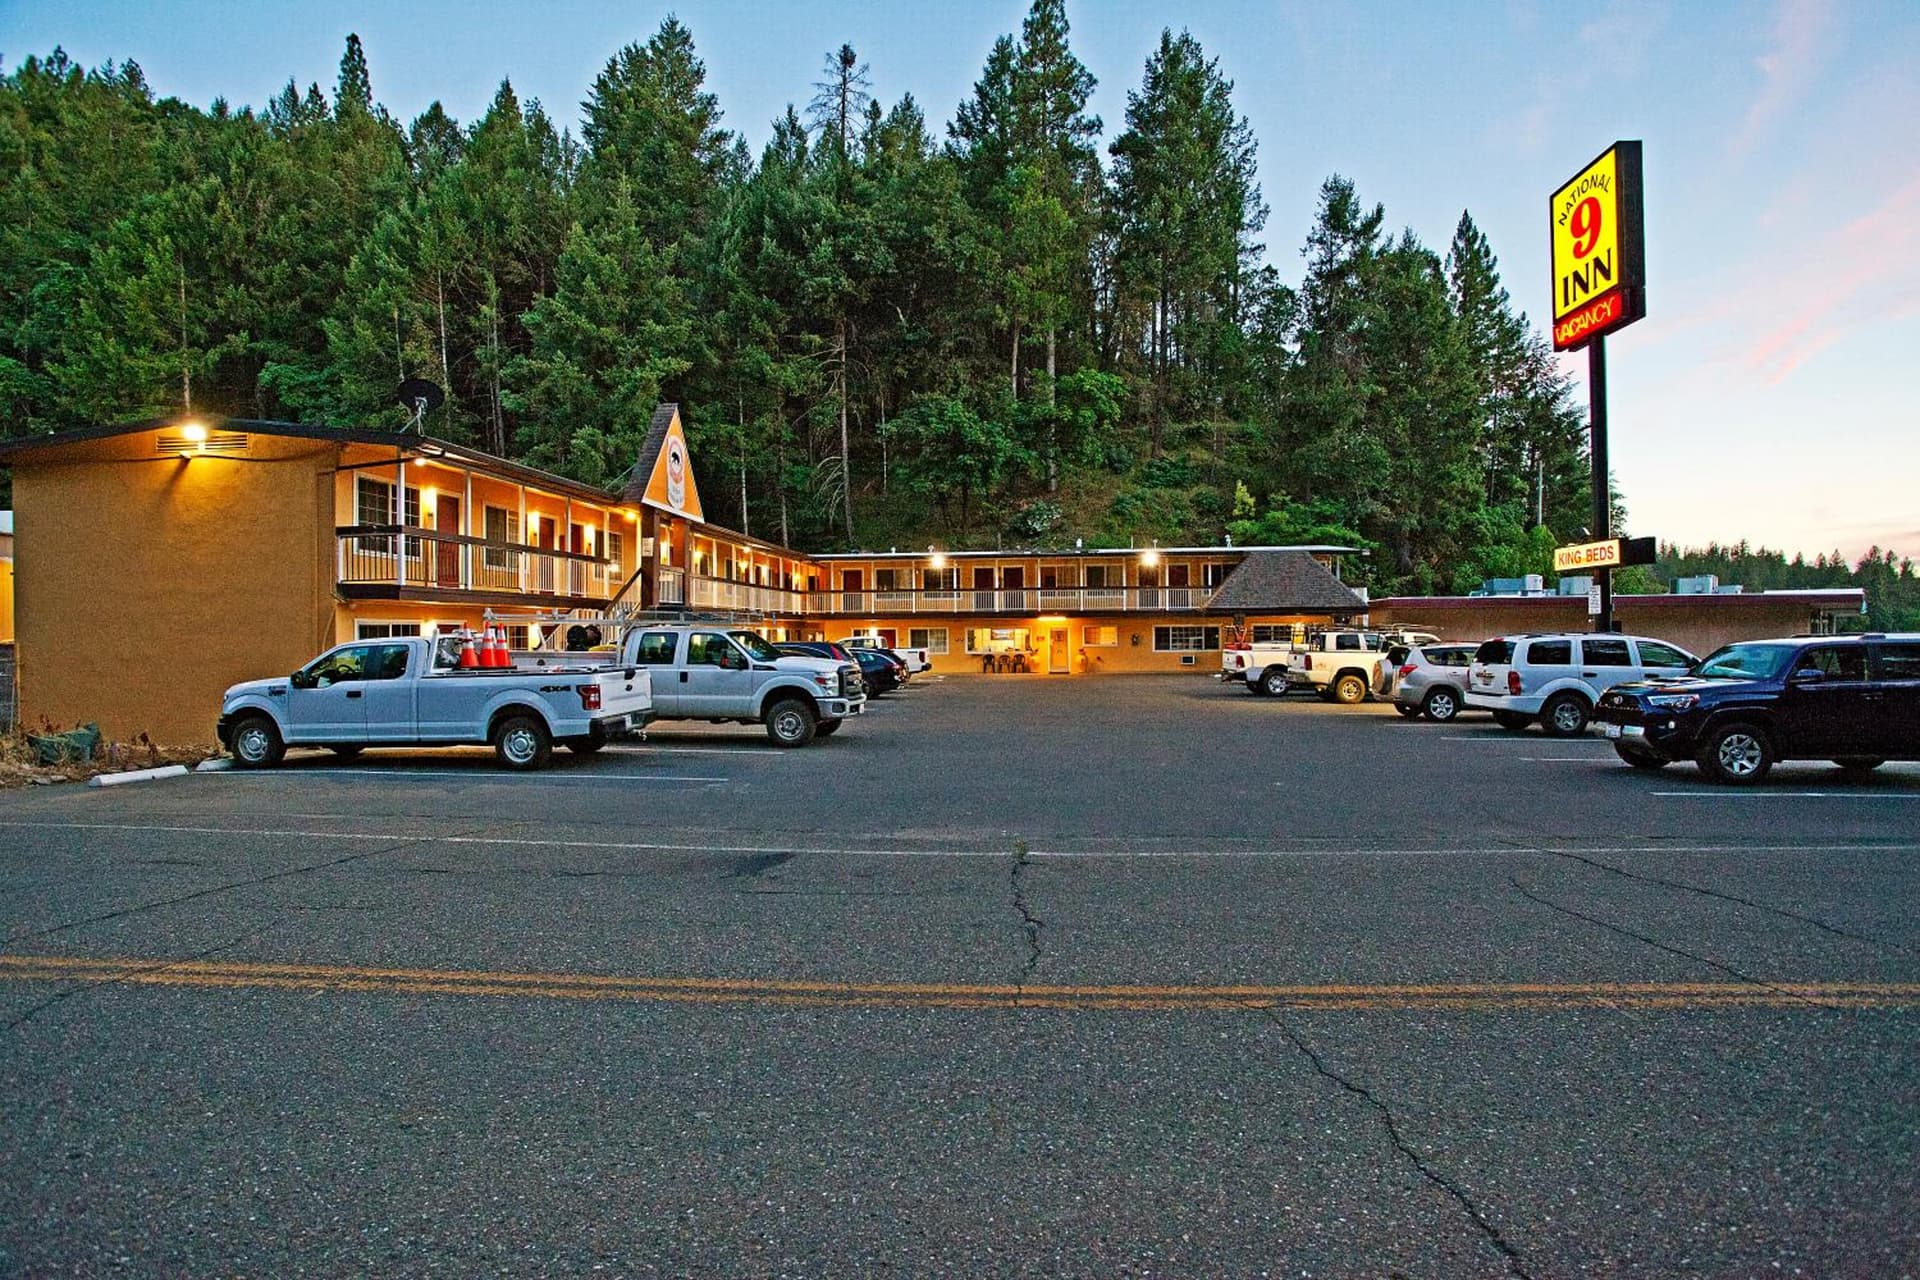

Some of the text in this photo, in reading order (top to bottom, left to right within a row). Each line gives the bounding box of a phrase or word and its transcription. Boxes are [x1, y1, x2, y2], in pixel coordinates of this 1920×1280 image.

[1558, 173, 1611, 226] NATIONAL
[1570, 196, 1602, 259] 9
[1563, 248, 1611, 308] INN
[1555, 296, 1615, 342] VACANCY
[1558, 545, 1615, 566] KING BEDS
